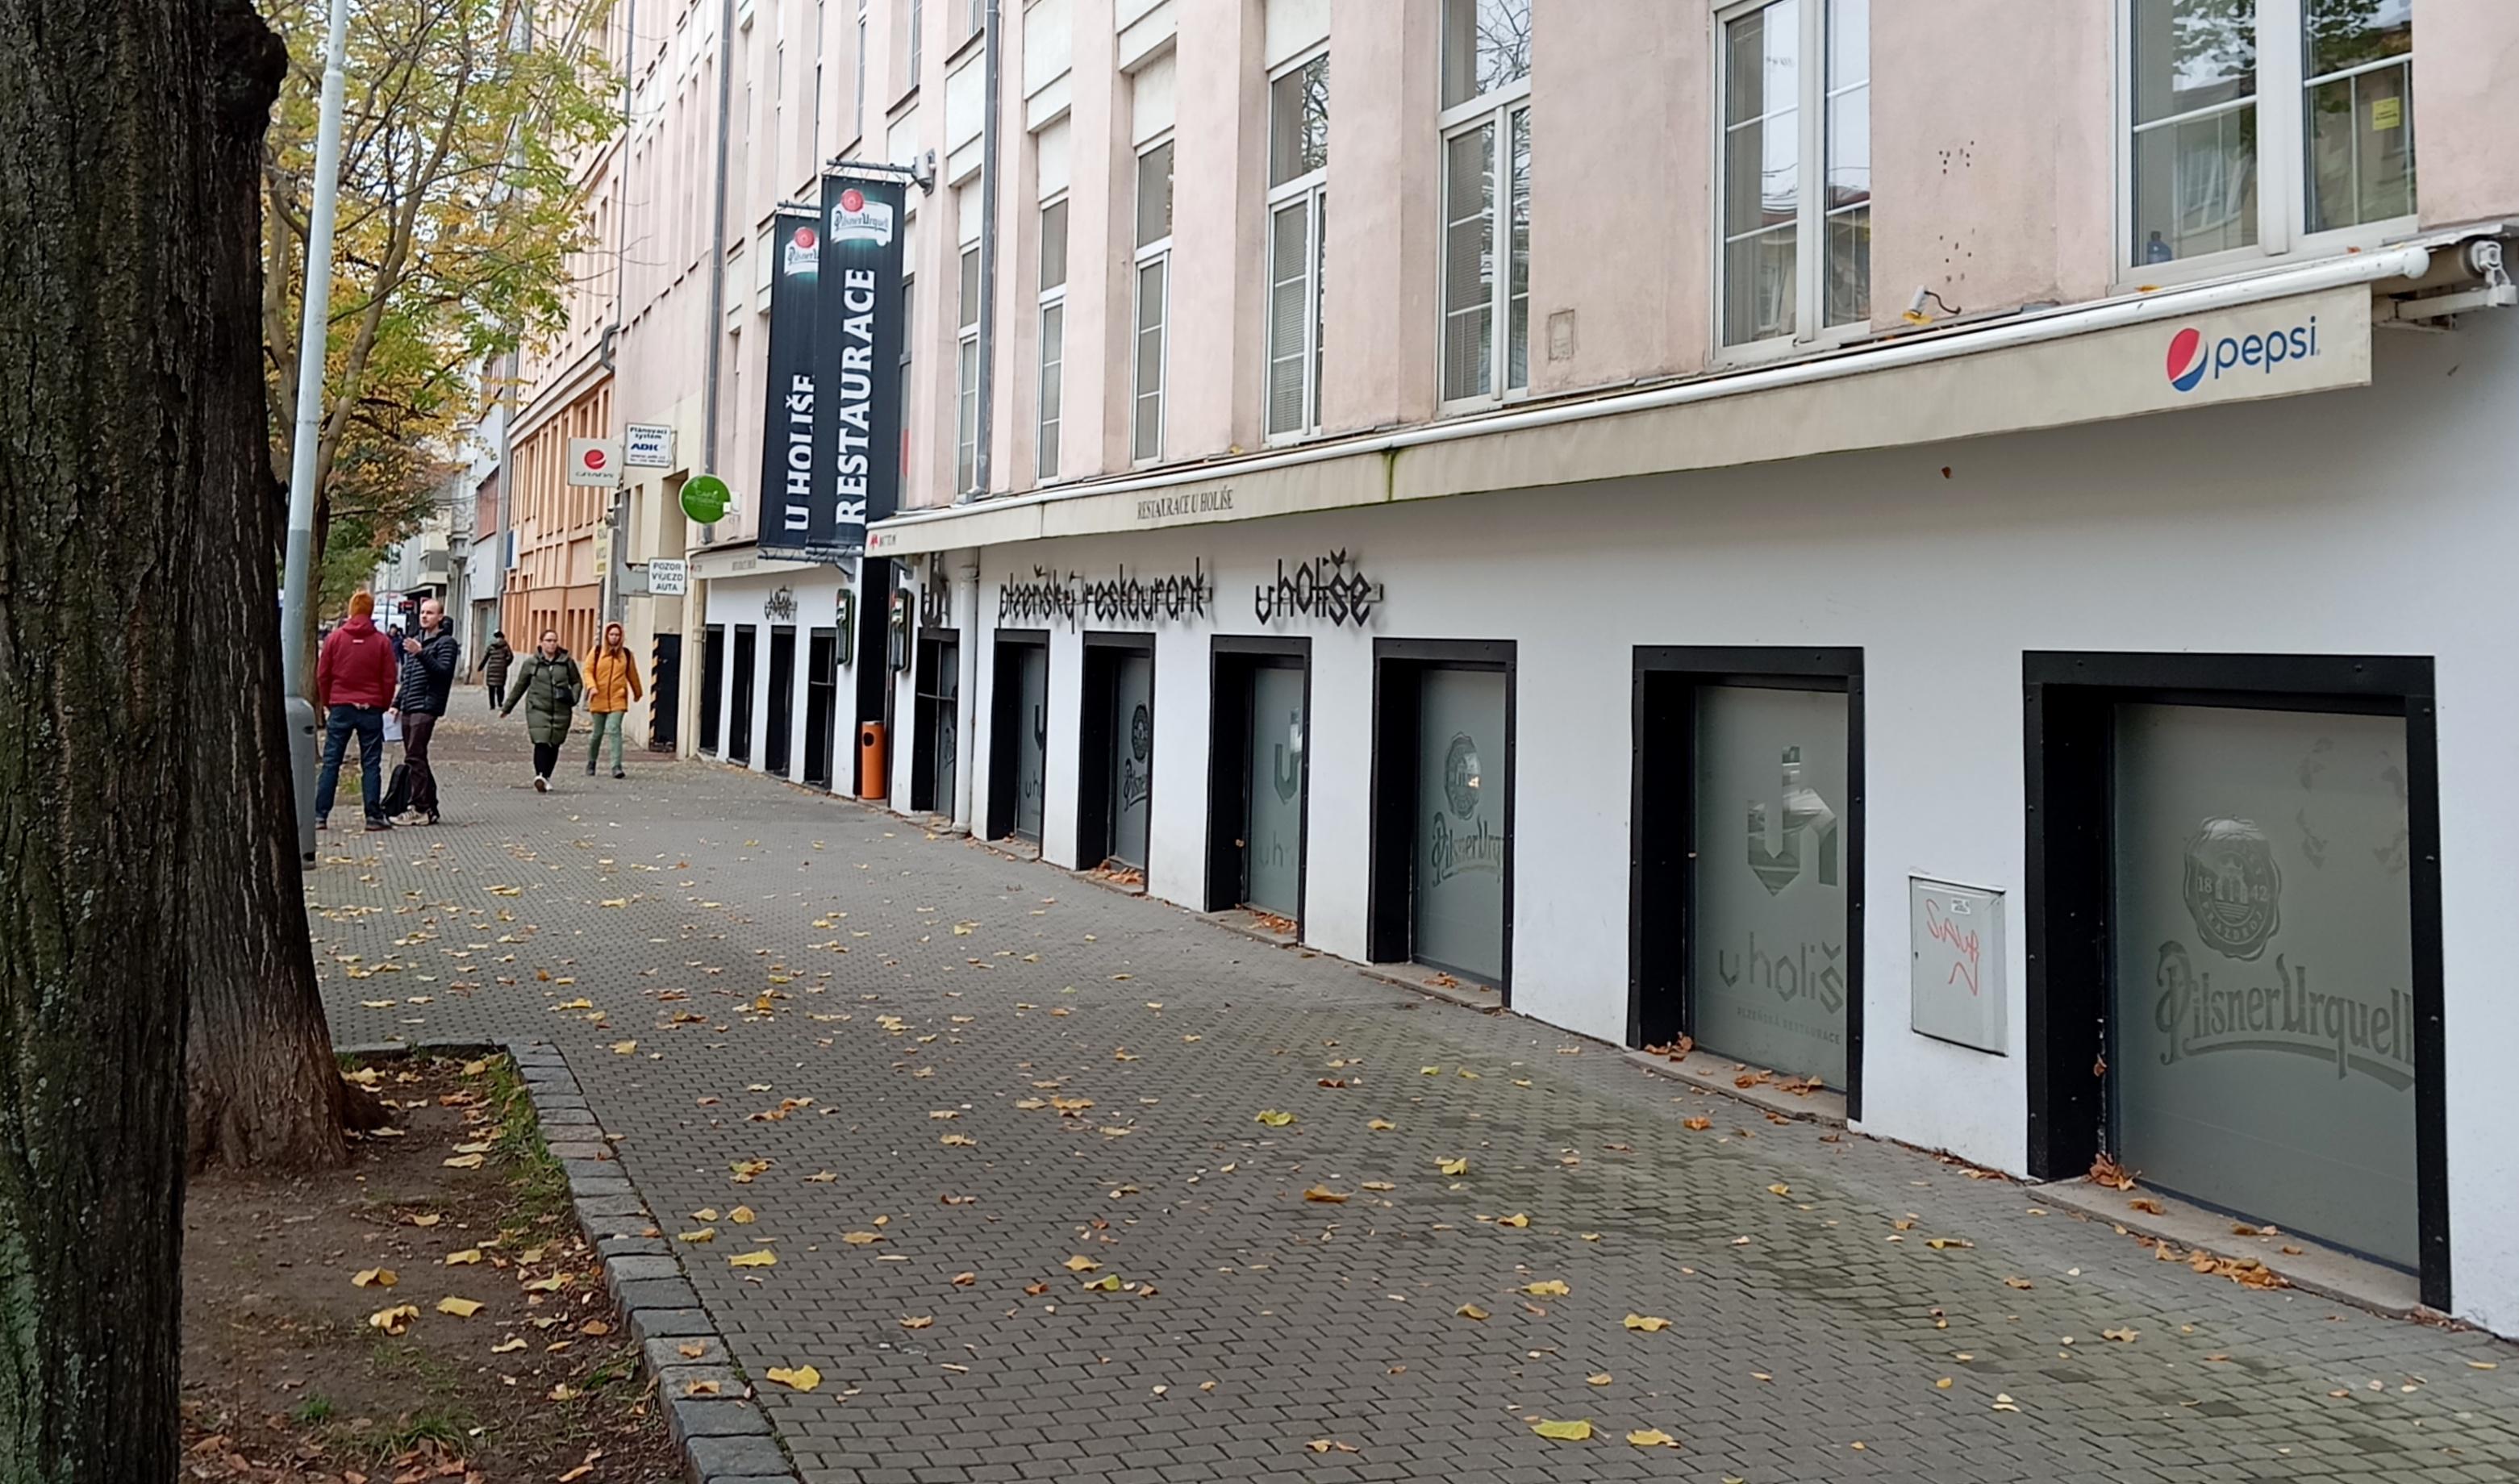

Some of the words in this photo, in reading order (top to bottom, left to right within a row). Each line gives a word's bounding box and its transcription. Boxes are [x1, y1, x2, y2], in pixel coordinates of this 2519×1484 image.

[2214, 315, 2317, 380] pepsi
[836, 269, 875, 525] RESTAURACE
[785, 504, 810, 531] U
[653, 562, 682, 570] POZOR
[656, 583, 678, 591] AUTA
[2154, 940, 2281, 1066] Pilsner
